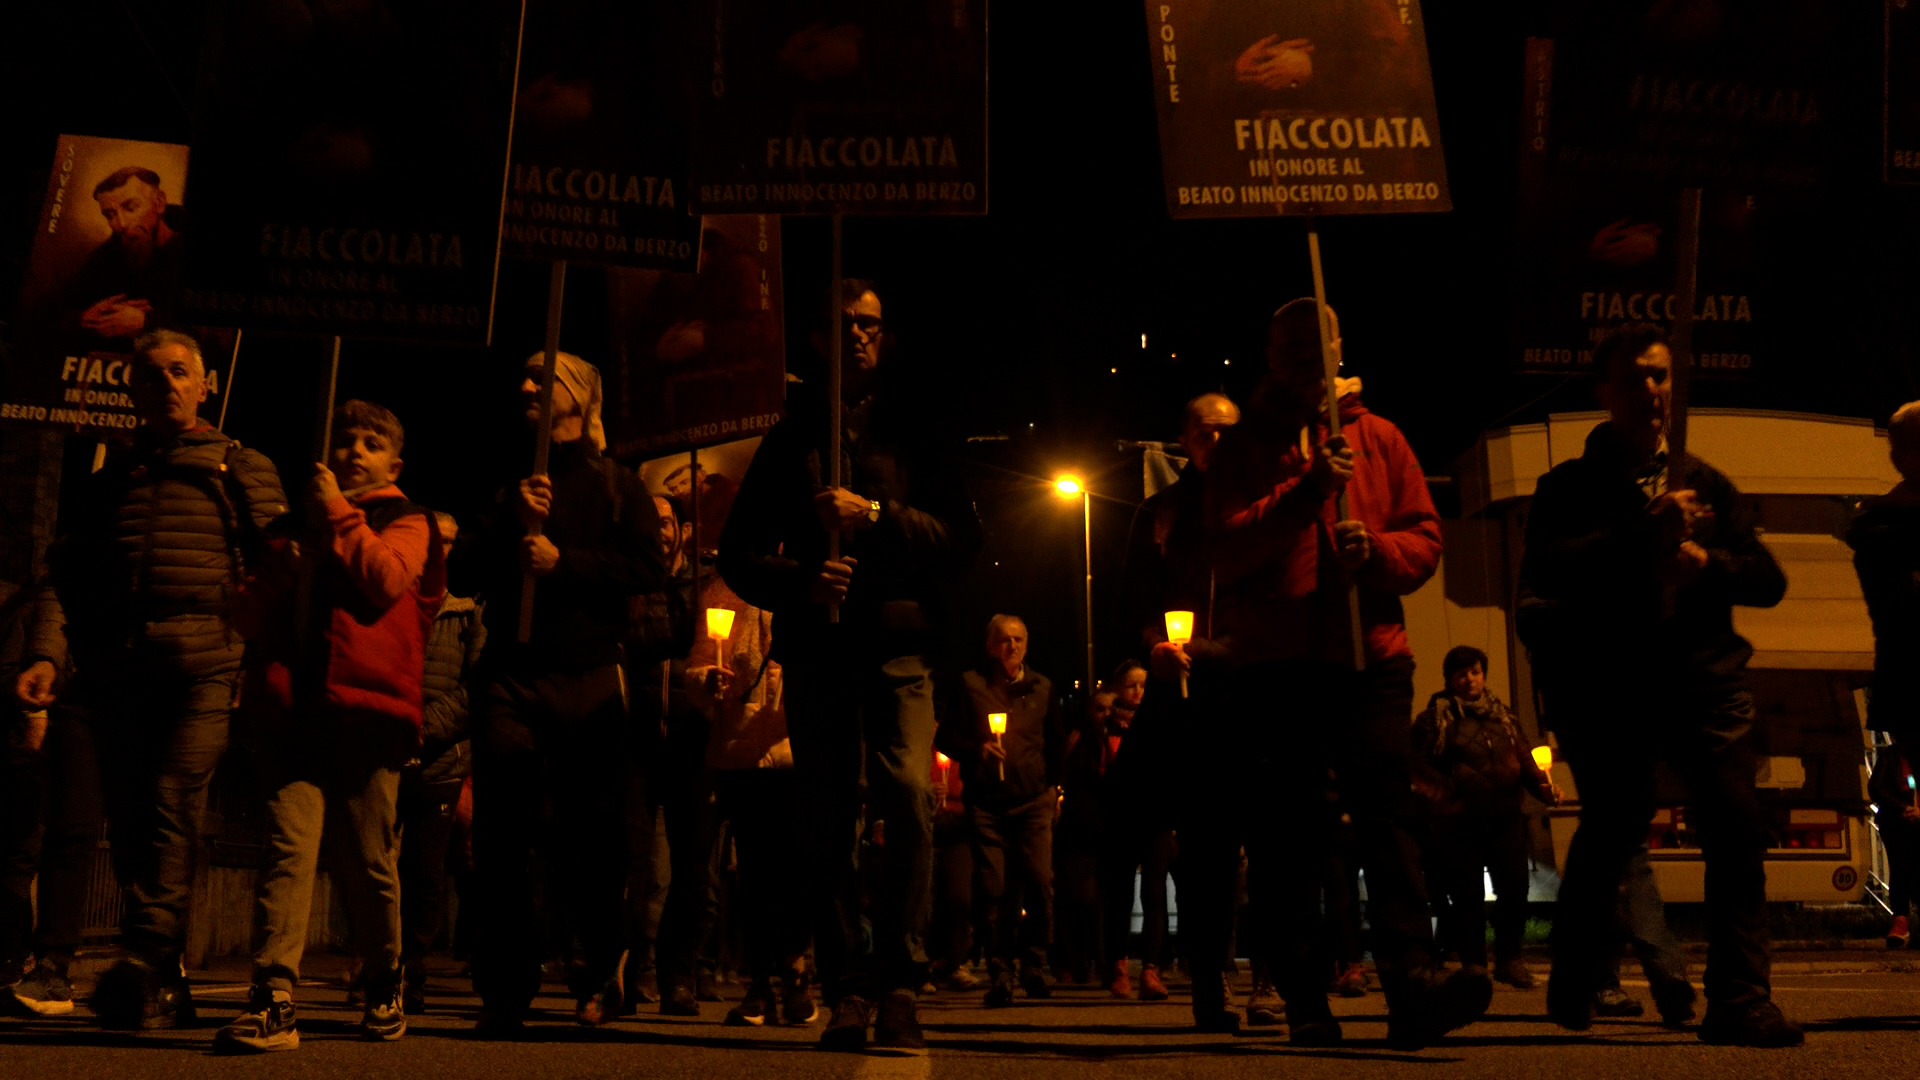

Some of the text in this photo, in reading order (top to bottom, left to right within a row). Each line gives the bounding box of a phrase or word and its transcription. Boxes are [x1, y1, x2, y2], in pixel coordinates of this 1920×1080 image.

[1160, 5, 1180, 103] PONTE
[1234, 117, 1432, 151] FIACCOLATA
[766, 135, 959, 169] FIACCOLATA
[1250, 157, 1365, 177] IN ONORE AL
[48, 143, 76, 233] SOVERE
[513, 162, 676, 211] IACCOLATA
[700, 181, 976, 202] BEATO INNOCENZO DA BERZO
[1178, 181, 1440, 205] BEATO INNOCENZO DA BERZO
[530, 201, 593, 225] ONORE
[599, 207, 619, 228] AL
[259, 223, 463, 269] FIACCOLATA
[604, 233, 628, 254] DA
[635, 236, 692, 261] BERZO
[1523, 348, 1572, 364] BEATO
[64, 388, 82, 402] IN
[0, 403, 47, 421] BEATO
[50, 407, 137, 429] INNOCENZO
[722, 419, 738, 433] DA
[741, 411, 780, 431] BERZO
